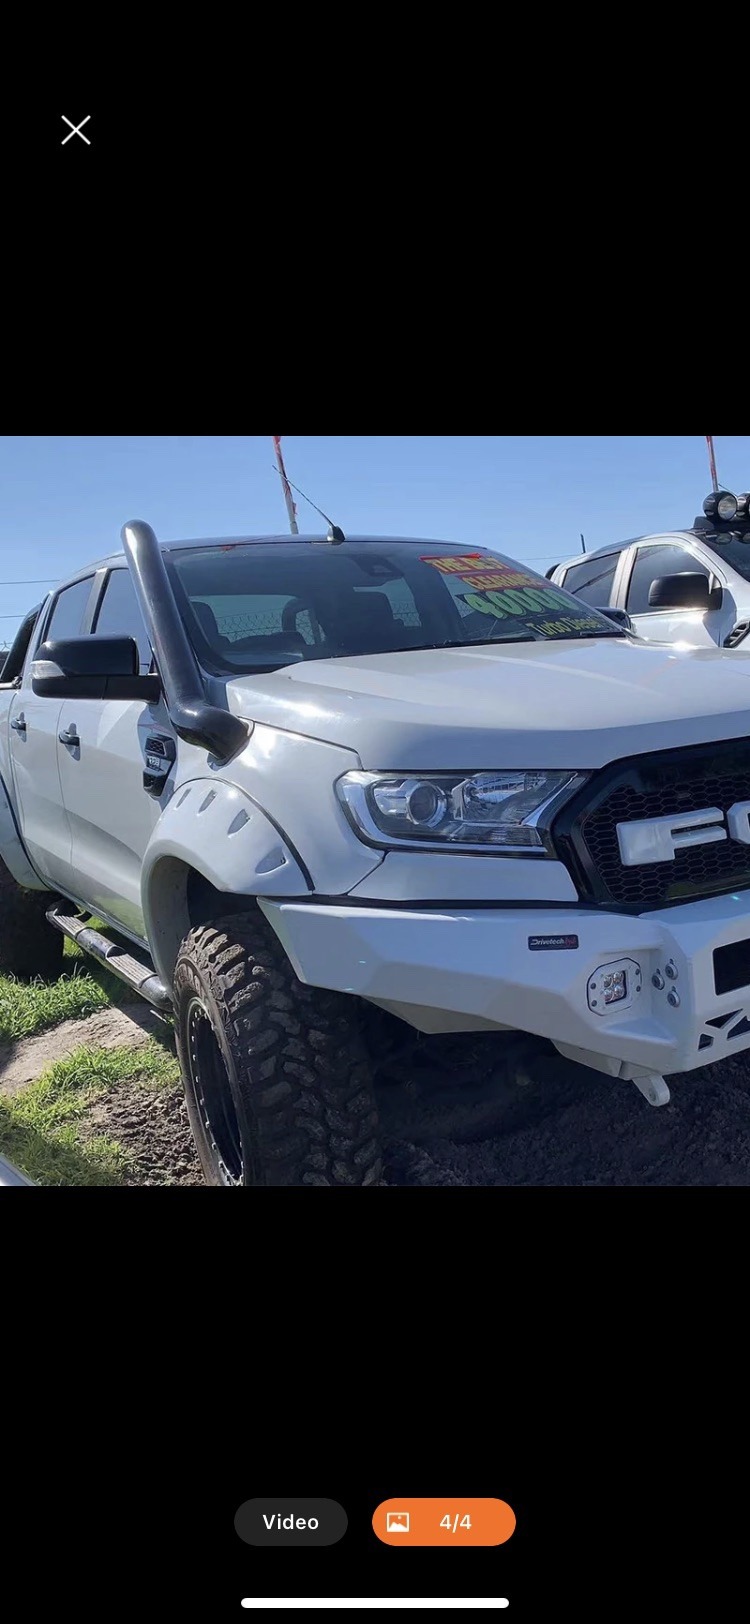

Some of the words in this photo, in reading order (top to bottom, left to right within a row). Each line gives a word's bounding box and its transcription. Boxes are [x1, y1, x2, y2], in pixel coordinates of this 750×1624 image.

[423, 557, 471, 573] THE
[525, 620, 572, 637] Turbo
[616, 800, 750, 867] F
[530, 938, 565, 946] Drivetech
